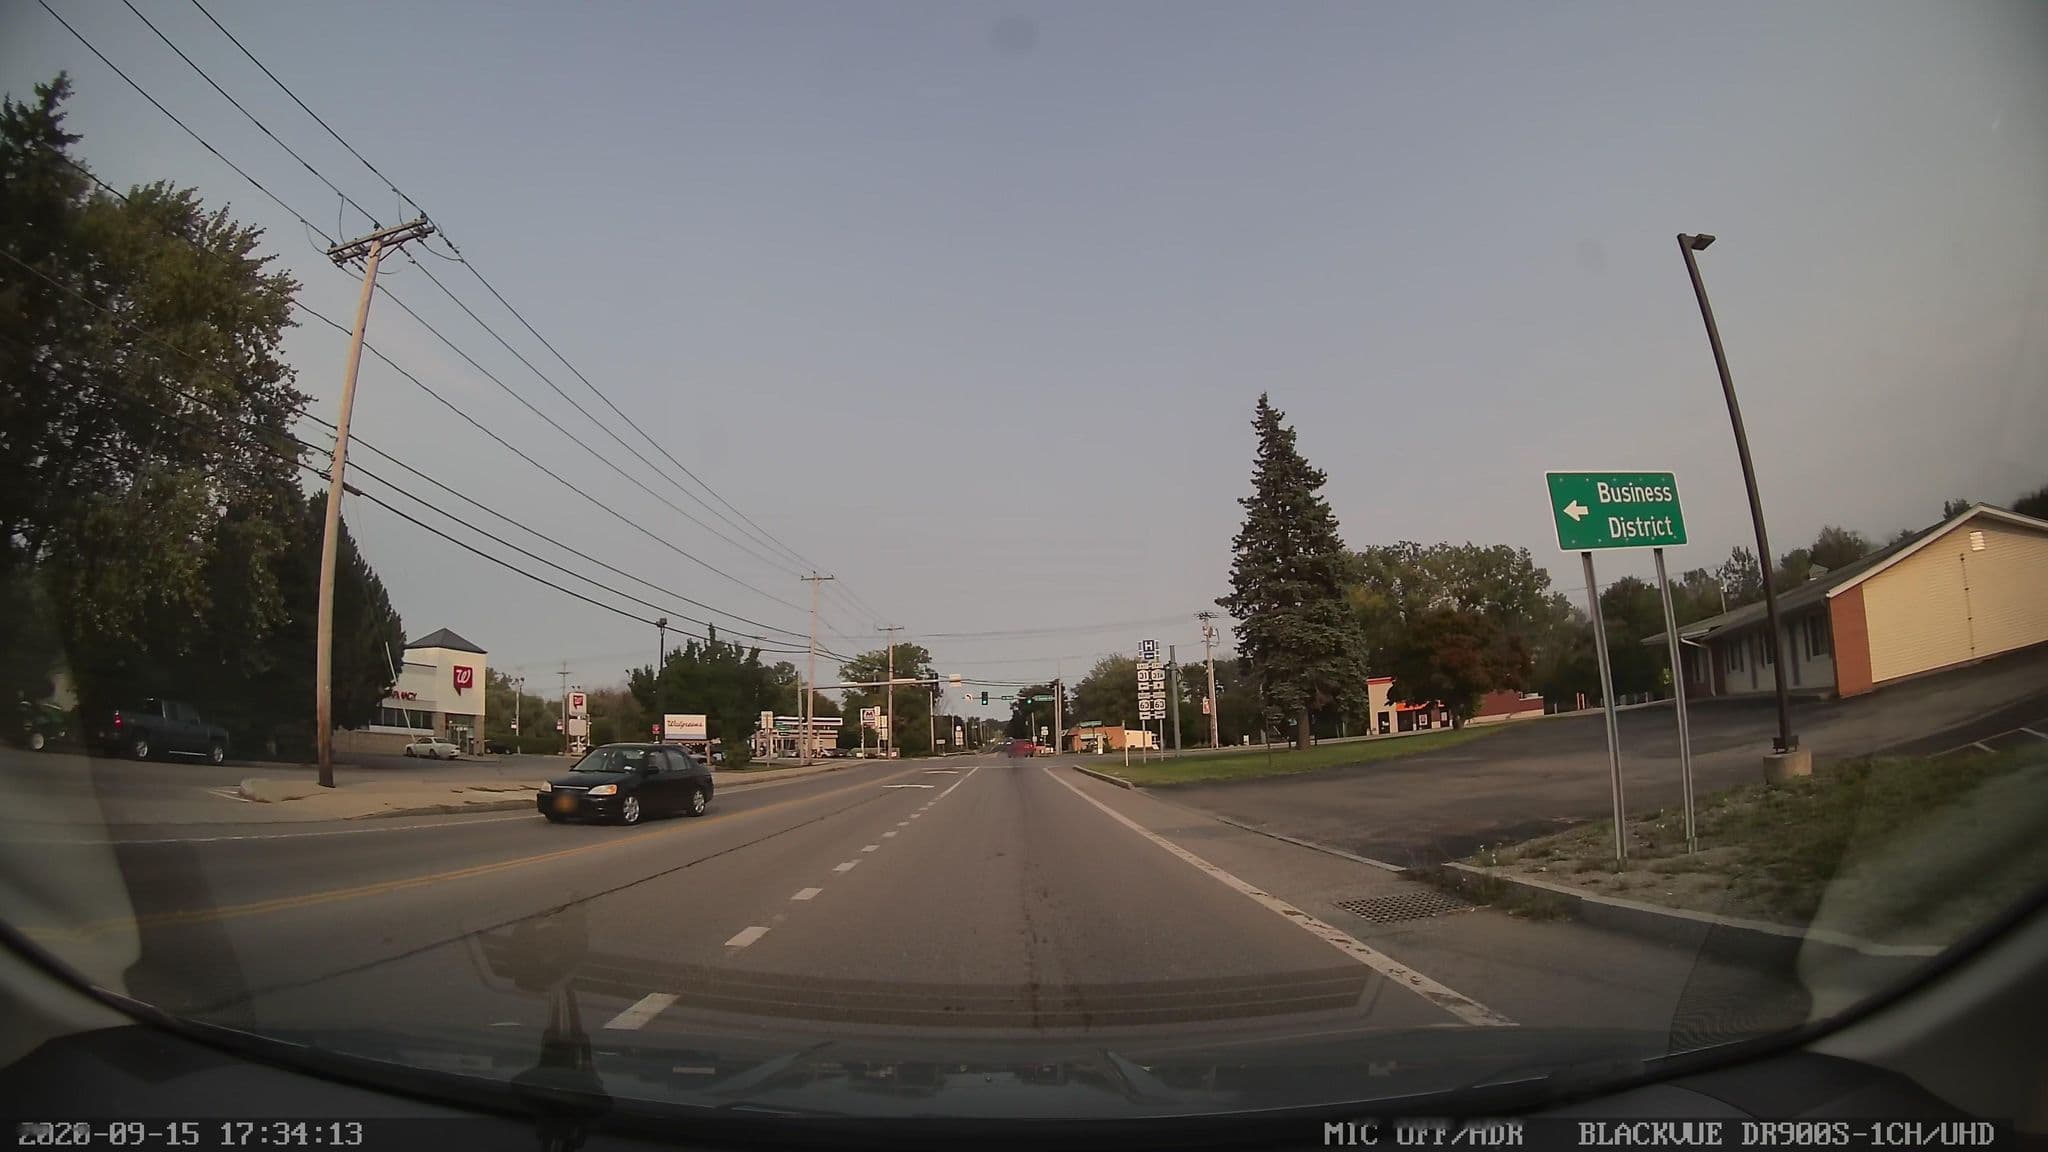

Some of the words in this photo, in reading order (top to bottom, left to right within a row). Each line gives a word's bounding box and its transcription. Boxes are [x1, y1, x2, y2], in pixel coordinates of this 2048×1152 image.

[1597, 481, 1673, 503] Business
[1608, 516, 1673, 538] District
[1144, 641, 1153, 651] H
[456, 669, 471, 684] W
[667, 720, 702, 729] Walgreens
